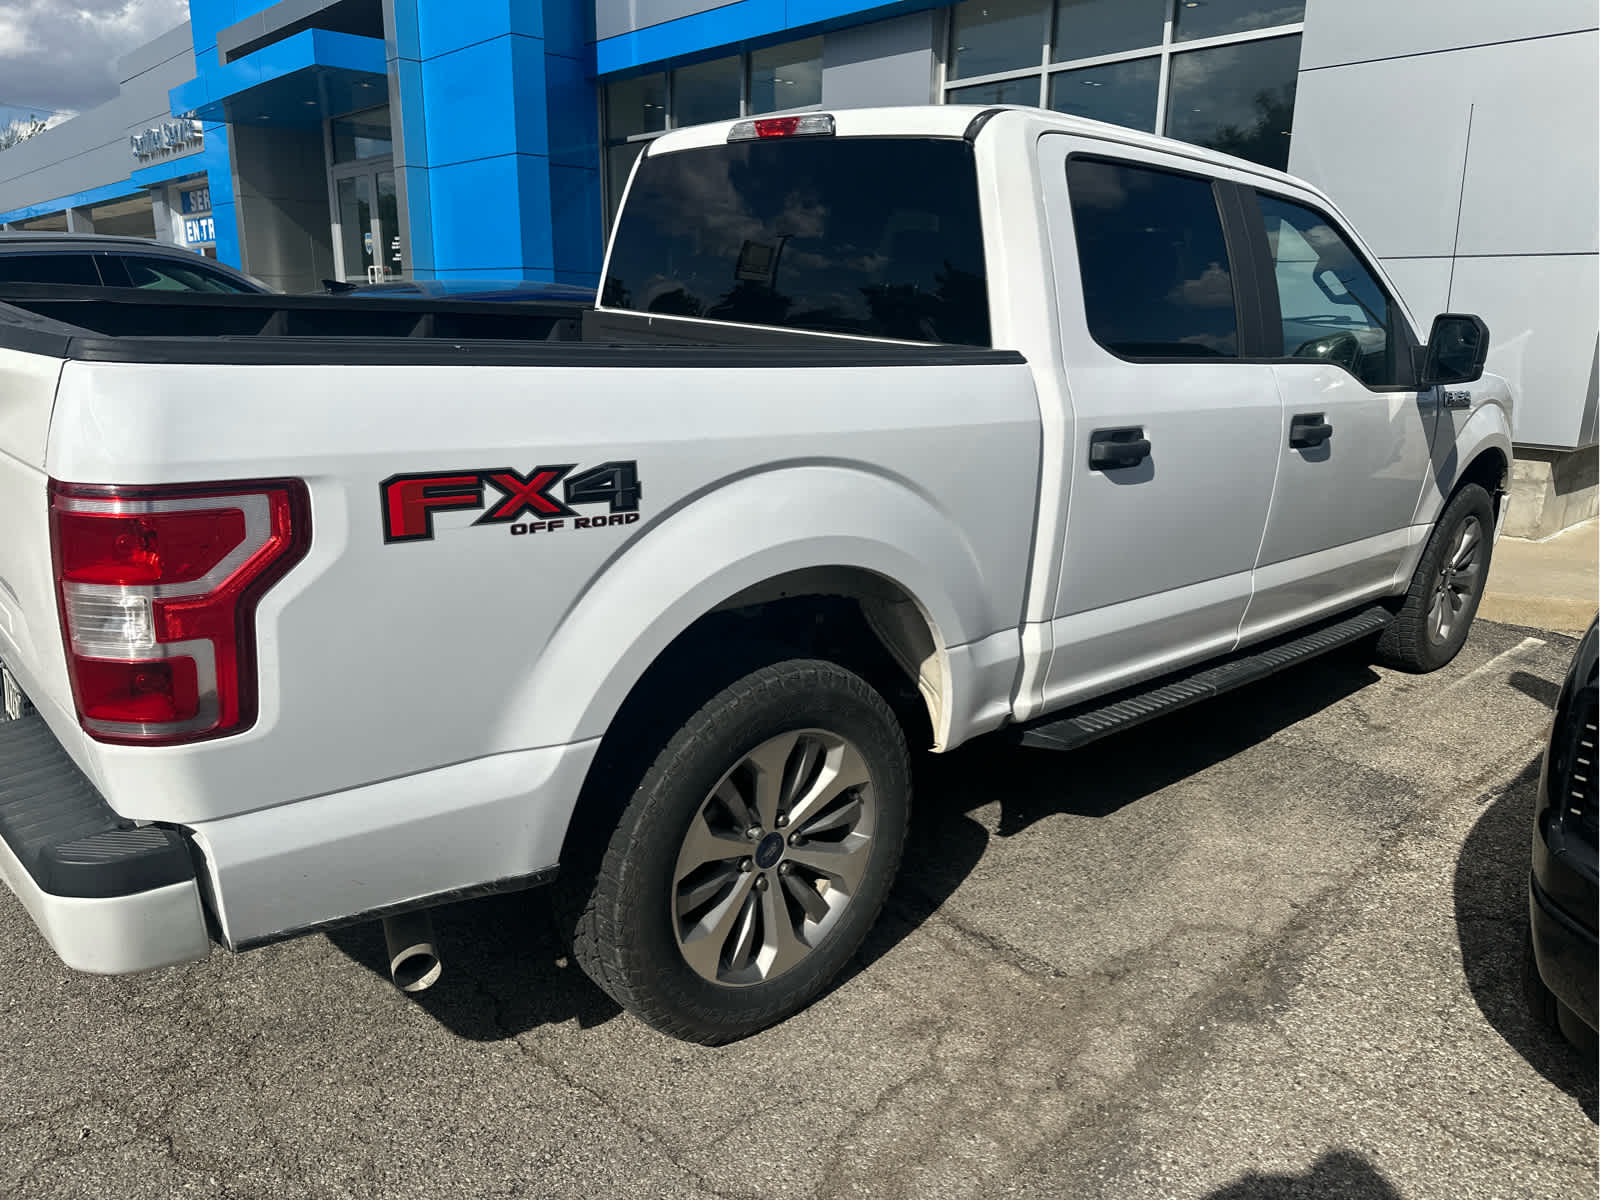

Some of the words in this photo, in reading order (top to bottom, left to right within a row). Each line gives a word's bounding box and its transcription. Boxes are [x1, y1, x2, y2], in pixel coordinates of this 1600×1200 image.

[379, 460, 642, 545] FX4
[510, 519, 564, 536] OFF
[574, 512, 641, 530] ROAD
